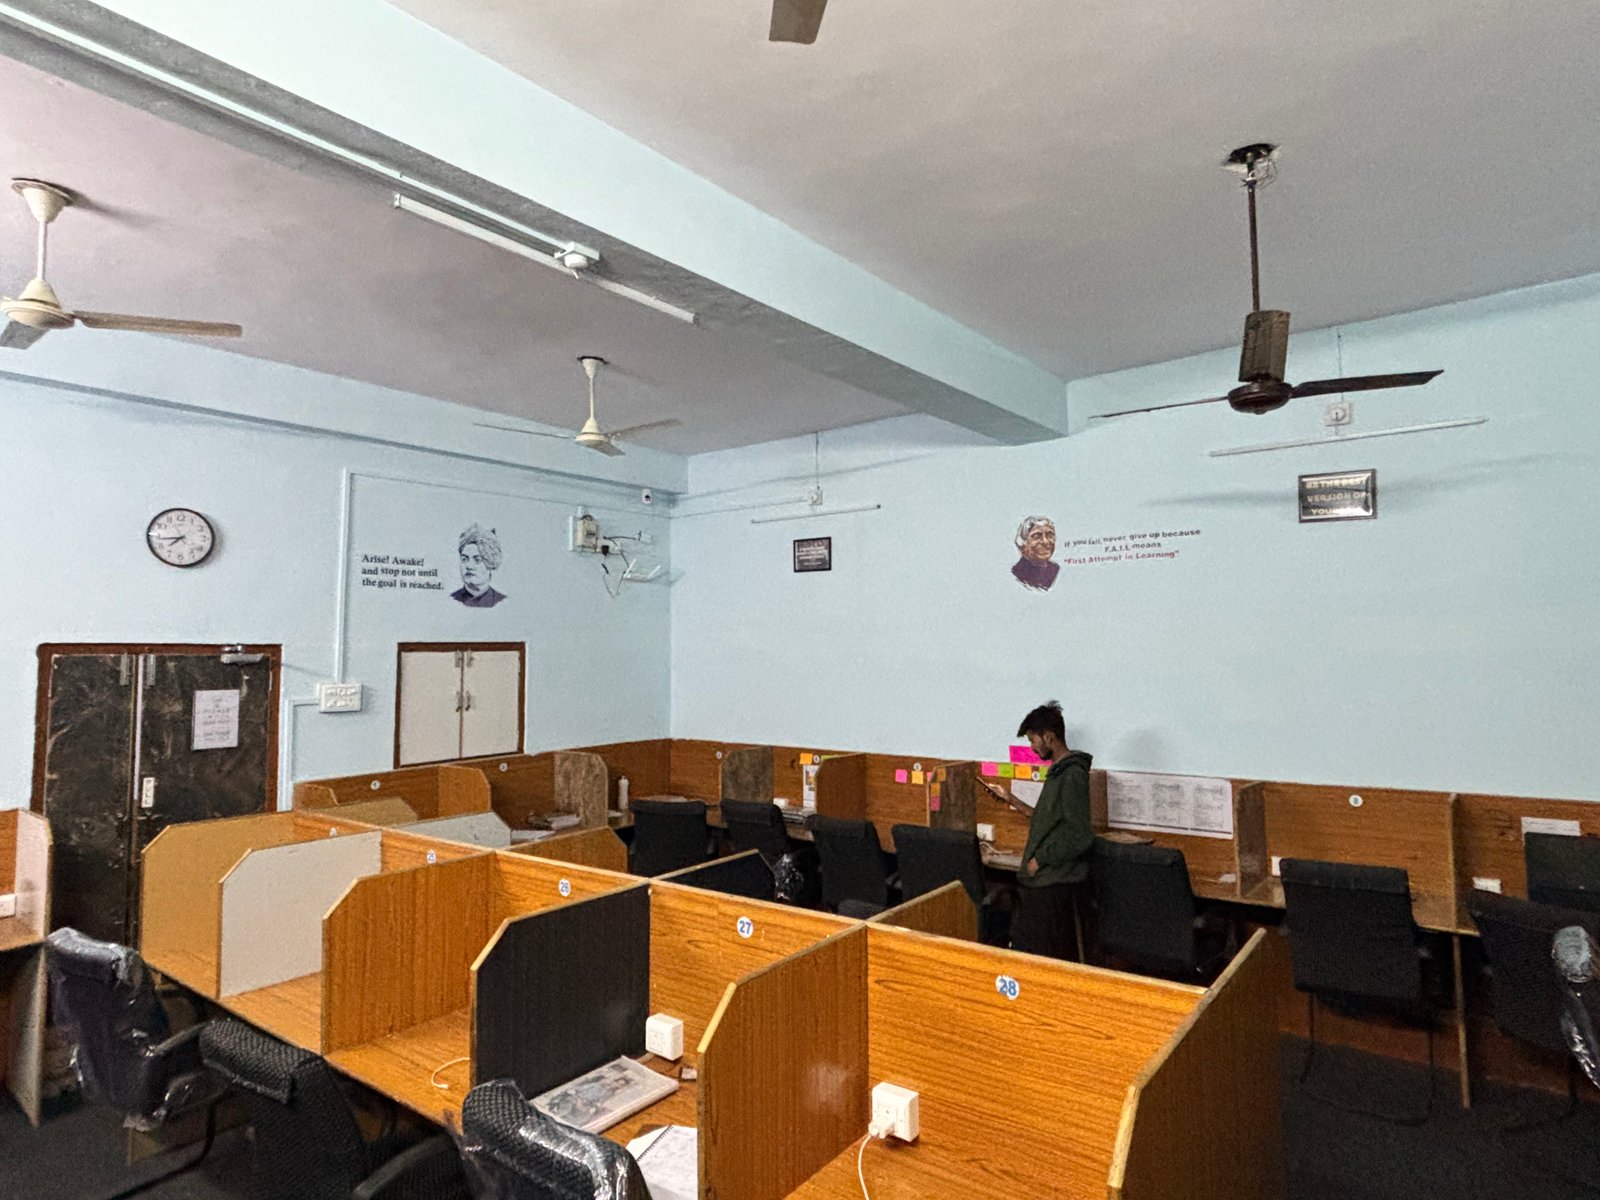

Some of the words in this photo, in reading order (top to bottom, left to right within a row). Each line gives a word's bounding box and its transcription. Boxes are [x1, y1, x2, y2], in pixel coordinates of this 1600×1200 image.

[1307, 493, 1351, 502] VERSION
[1072, 540, 1087, 548] you
[1129, 533, 1148, 541] give
[1161, 529, 1201, 538] because
[361, 554, 390, 564] Arise!
[392, 557, 424, 567] Awake!
[1088, 555, 1121, 563] Attempt
[361, 567, 379, 575] and
[381, 568, 400, 577] stop
[418, 569, 438, 577] until
[362, 578, 376, 587] the
[377, 580, 397, 589] goal
[409, 582, 444, 591] reached.
[739, 920, 752, 935] 27
[999, 978, 1017, 996] 28
